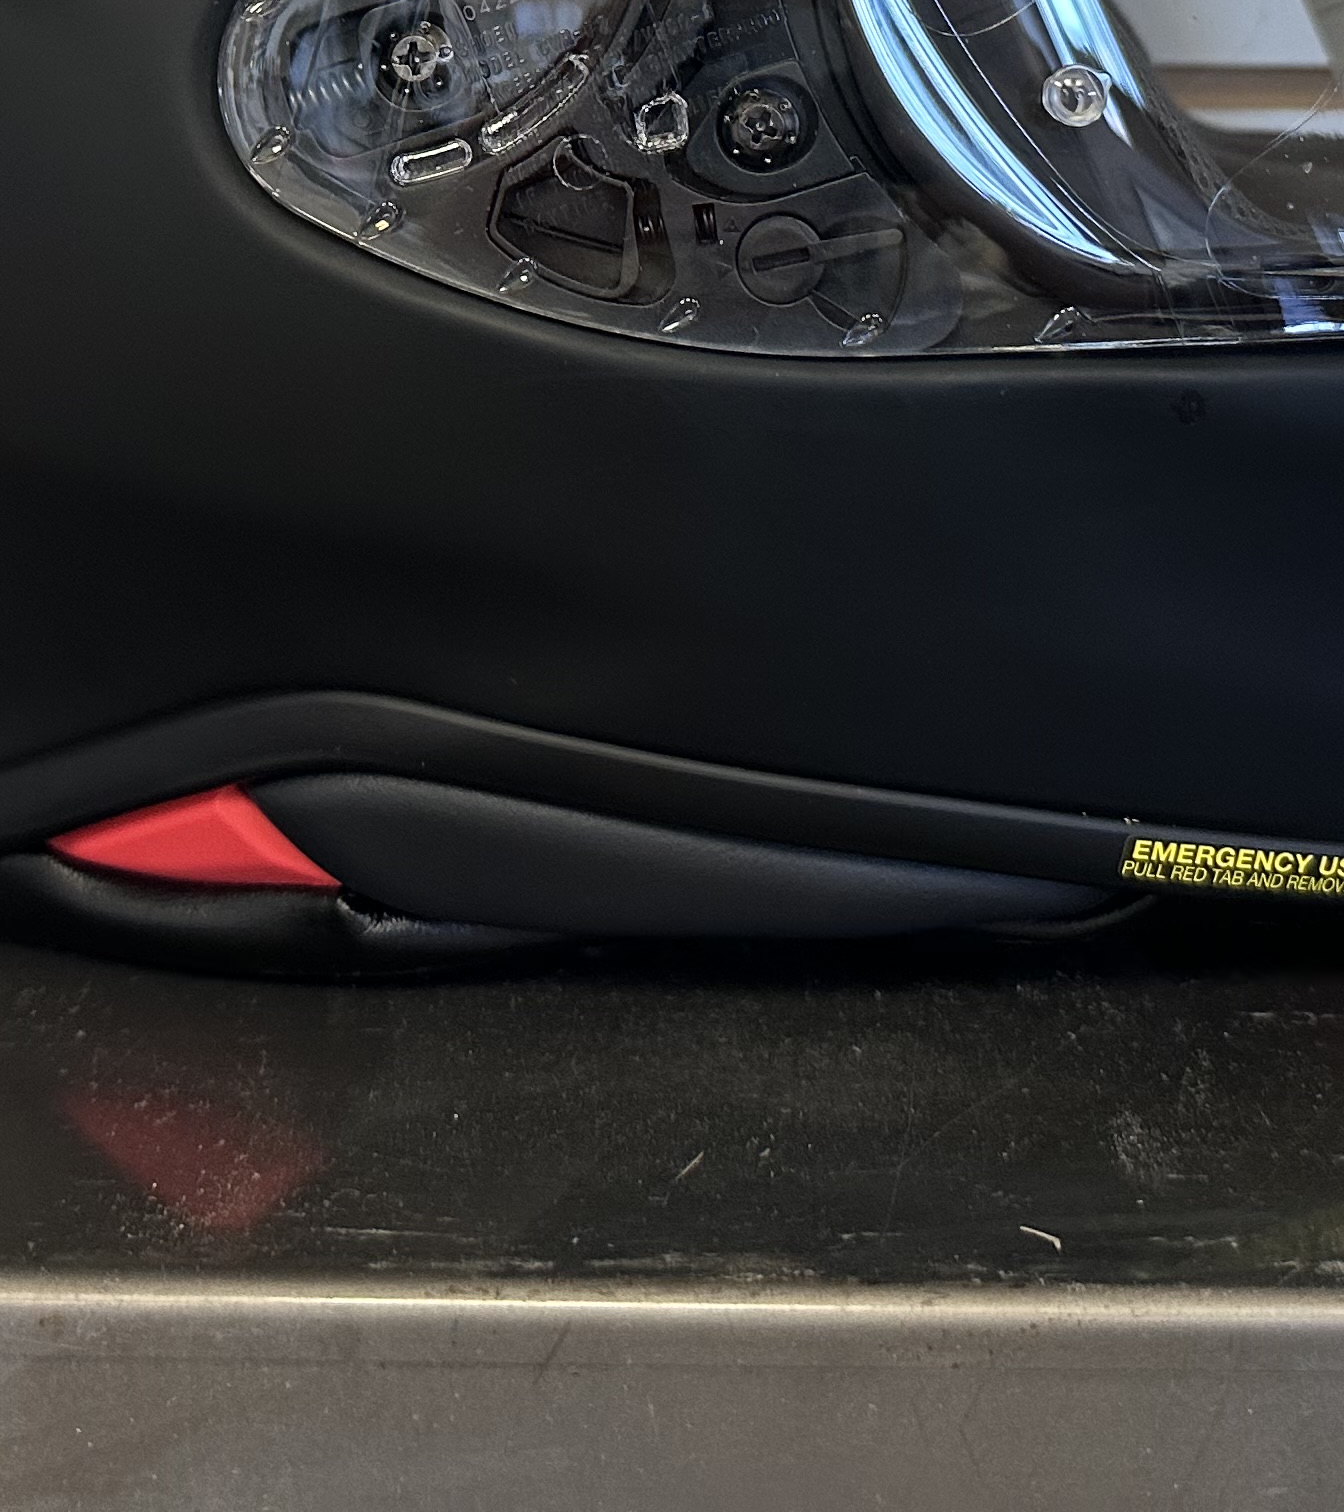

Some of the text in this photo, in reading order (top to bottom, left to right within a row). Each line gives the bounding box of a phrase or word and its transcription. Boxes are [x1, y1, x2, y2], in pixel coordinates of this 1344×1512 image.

[1132, 840, 1313, 874] EMERGENCY
[1122, 860, 1166, 879] PULL
[1170, 863, 1206, 883] RED
[1212, 868, 1245, 886] TAB
[1247, 870, 1283, 889] AND
